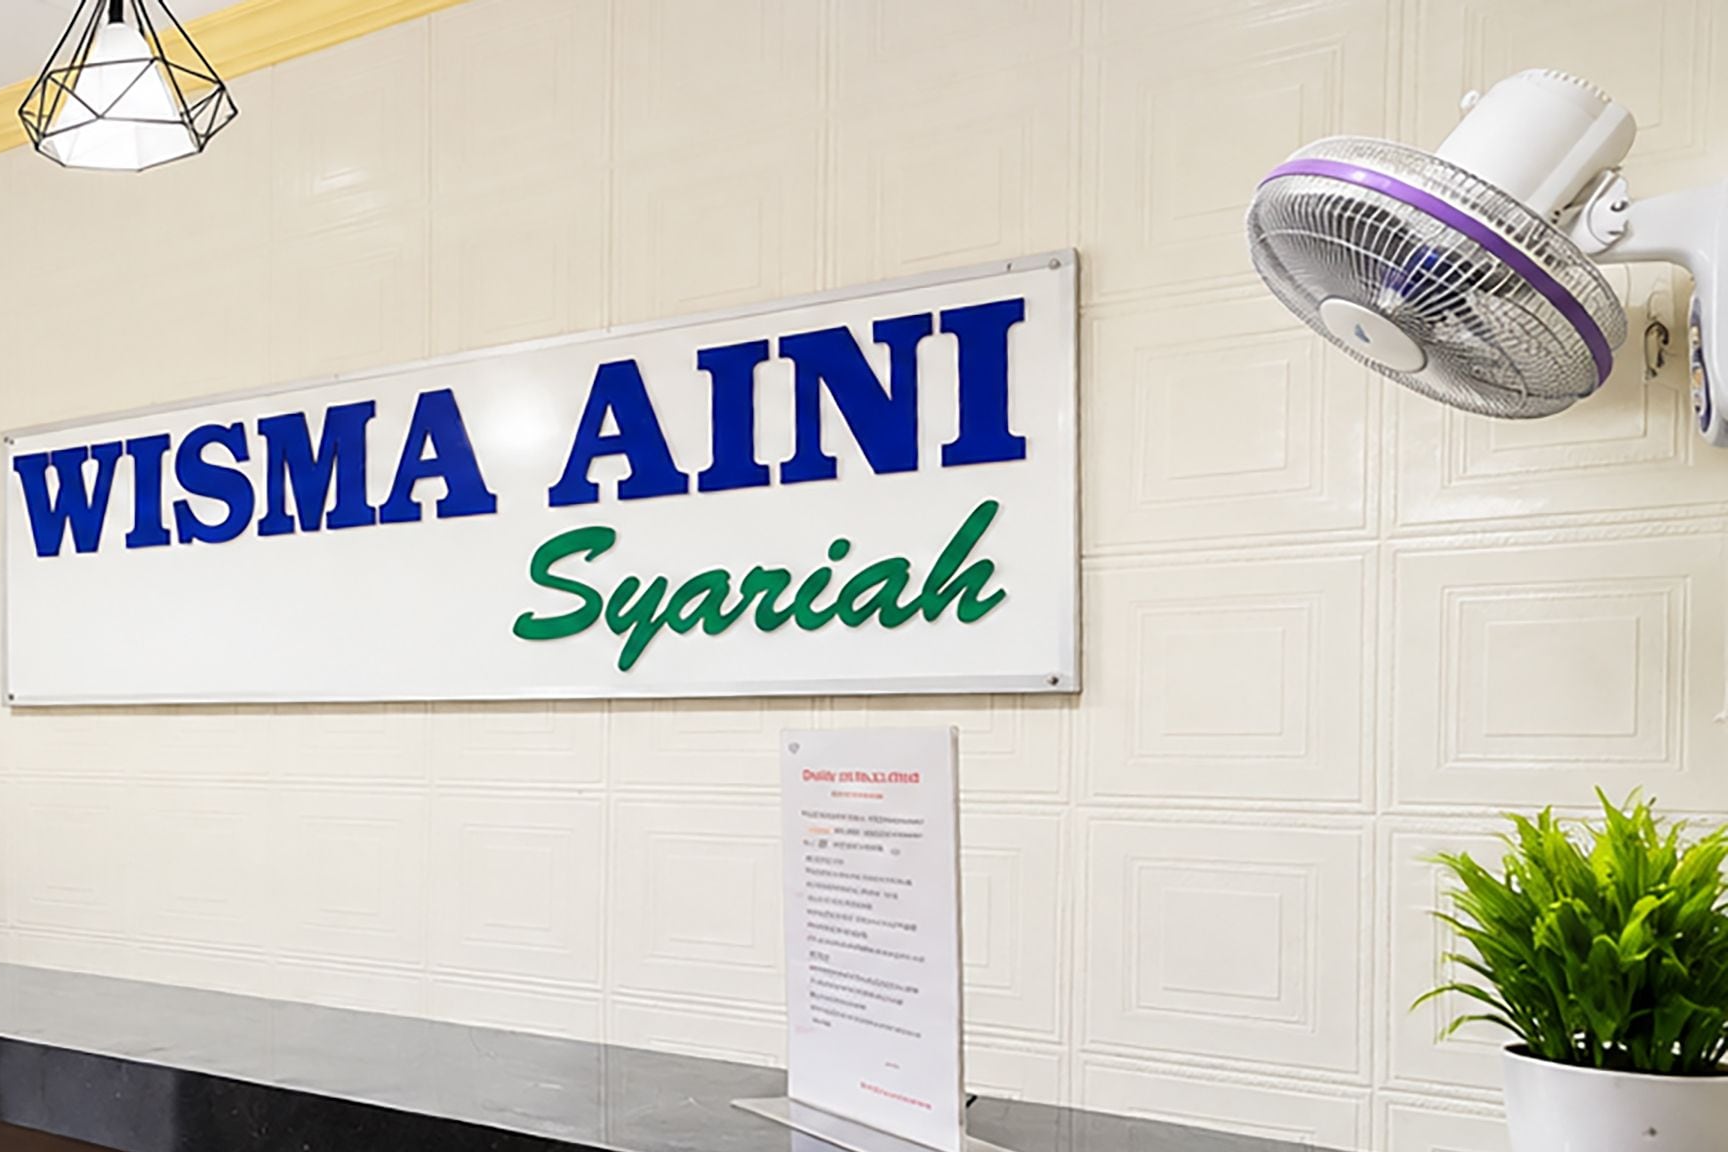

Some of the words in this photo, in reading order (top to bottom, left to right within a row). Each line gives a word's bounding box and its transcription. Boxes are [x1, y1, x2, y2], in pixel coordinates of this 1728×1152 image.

[13, 389, 497, 557] WISMA
[548, 298, 1026, 507] AINI
[512, 500, 1005, 671] Syariah
